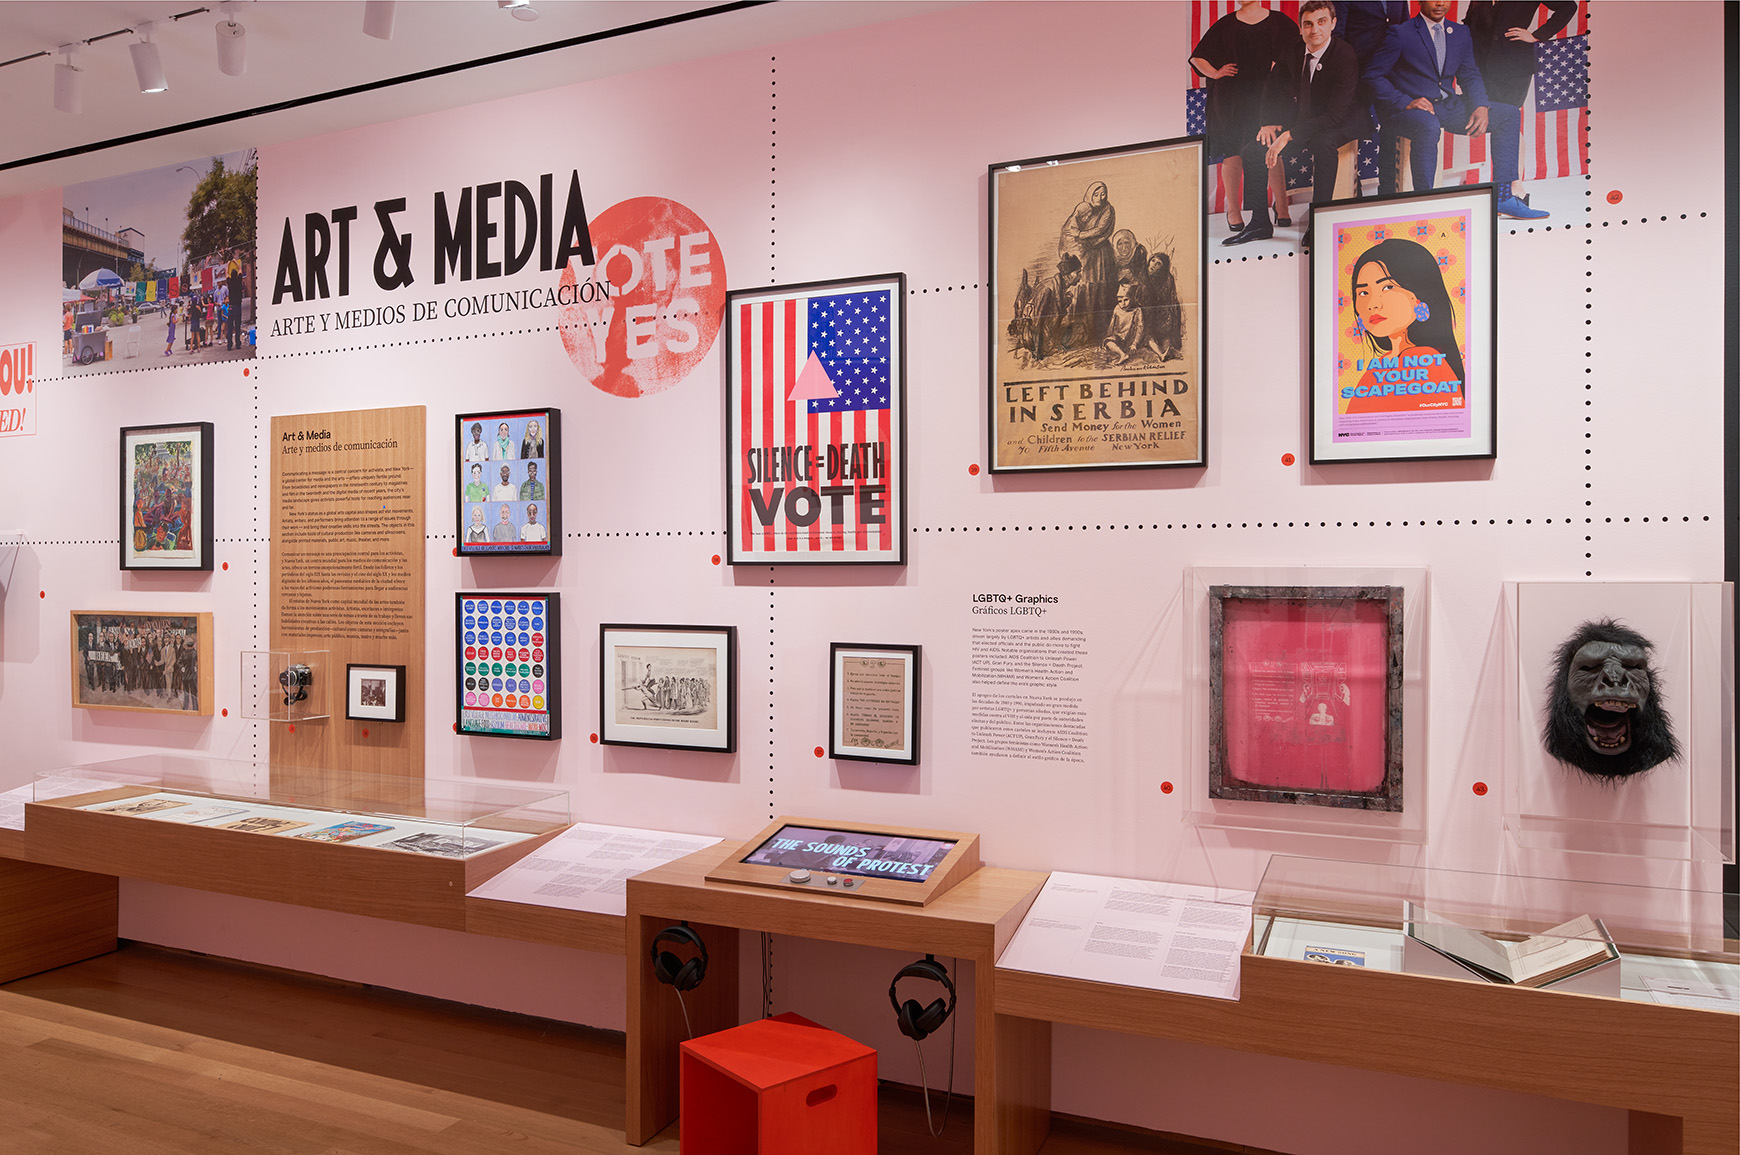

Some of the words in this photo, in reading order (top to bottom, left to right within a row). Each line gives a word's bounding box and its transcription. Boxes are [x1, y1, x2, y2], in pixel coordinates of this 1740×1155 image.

[272, 205, 358, 305] ART
[373, 197, 415, 291] &
[434, 169, 596, 285] MEDIA
[270, 315, 316, 338] ARTE
[320, 312, 332, 332] Y
[334, 304, 406, 330] MEDIOS
[412, 300, 438, 321] DE
[444, 276, 612, 320] COMUNICACIÓN
[586, 299, 700, 363] YES
[1356, 359, 1364, 371] I
[1367, 355, 1399, 370] AM
[1402, 354, 1446, 368] NOT
[1372, 368, 1430, 384] YOUR
[1006, 384, 1070, 403] LEFT
[1080, 379, 1189, 400] BEHIND
[1341, 380, 1462, 399] SCAPEGOAT
[1010, 405, 1036, 424] IN
[1050, 398, 1182, 422] SERBIA
[1040, 422, 1068, 433] Send
[1072, 422, 1109, 433] Money
[1112, 422, 1124, 431] for
[1126, 421, 1137, 430] the
[1141, 420, 1182, 429] Women
[282, 432, 296, 442] Art
[298, 431, 304, 441] &
[306, 430, 331, 440] Media
[1028, 434, 1072, 444] Children
[1077, 435, 1085, 443] to
[1085, 434, 1098, 443] the
[1102, 432, 1146, 442] SERBIAN
[1150, 430, 1187, 441] RELIEF
[282, 444, 298, 454] Arte
[299, 446, 304, 456] y
[305, 442, 332, 453] medios
[332, 442, 342, 452] de
[344, 438, 398, 451] comunicación
[1037, 444, 1062, 454] Fifth
[1064, 444, 1096, 452] Avenue
[1112, 443, 1132, 451] New
[1132, 442, 1160, 450] York
[748, 484, 886, 528] VOTE
[972, 594, 1012, 603] LGBTQ+
[1015, 594, 1059, 605] Graphics
[972, 606, 1008, 615] Gráficos
[1010, 606, 1048, 617] LGBTQ+
[772, 838, 804, 851] THE
[802, 842, 871, 858] SOUNDS
[832, 856, 858, 868] OF
[856, 858, 934, 876] PROTEST
